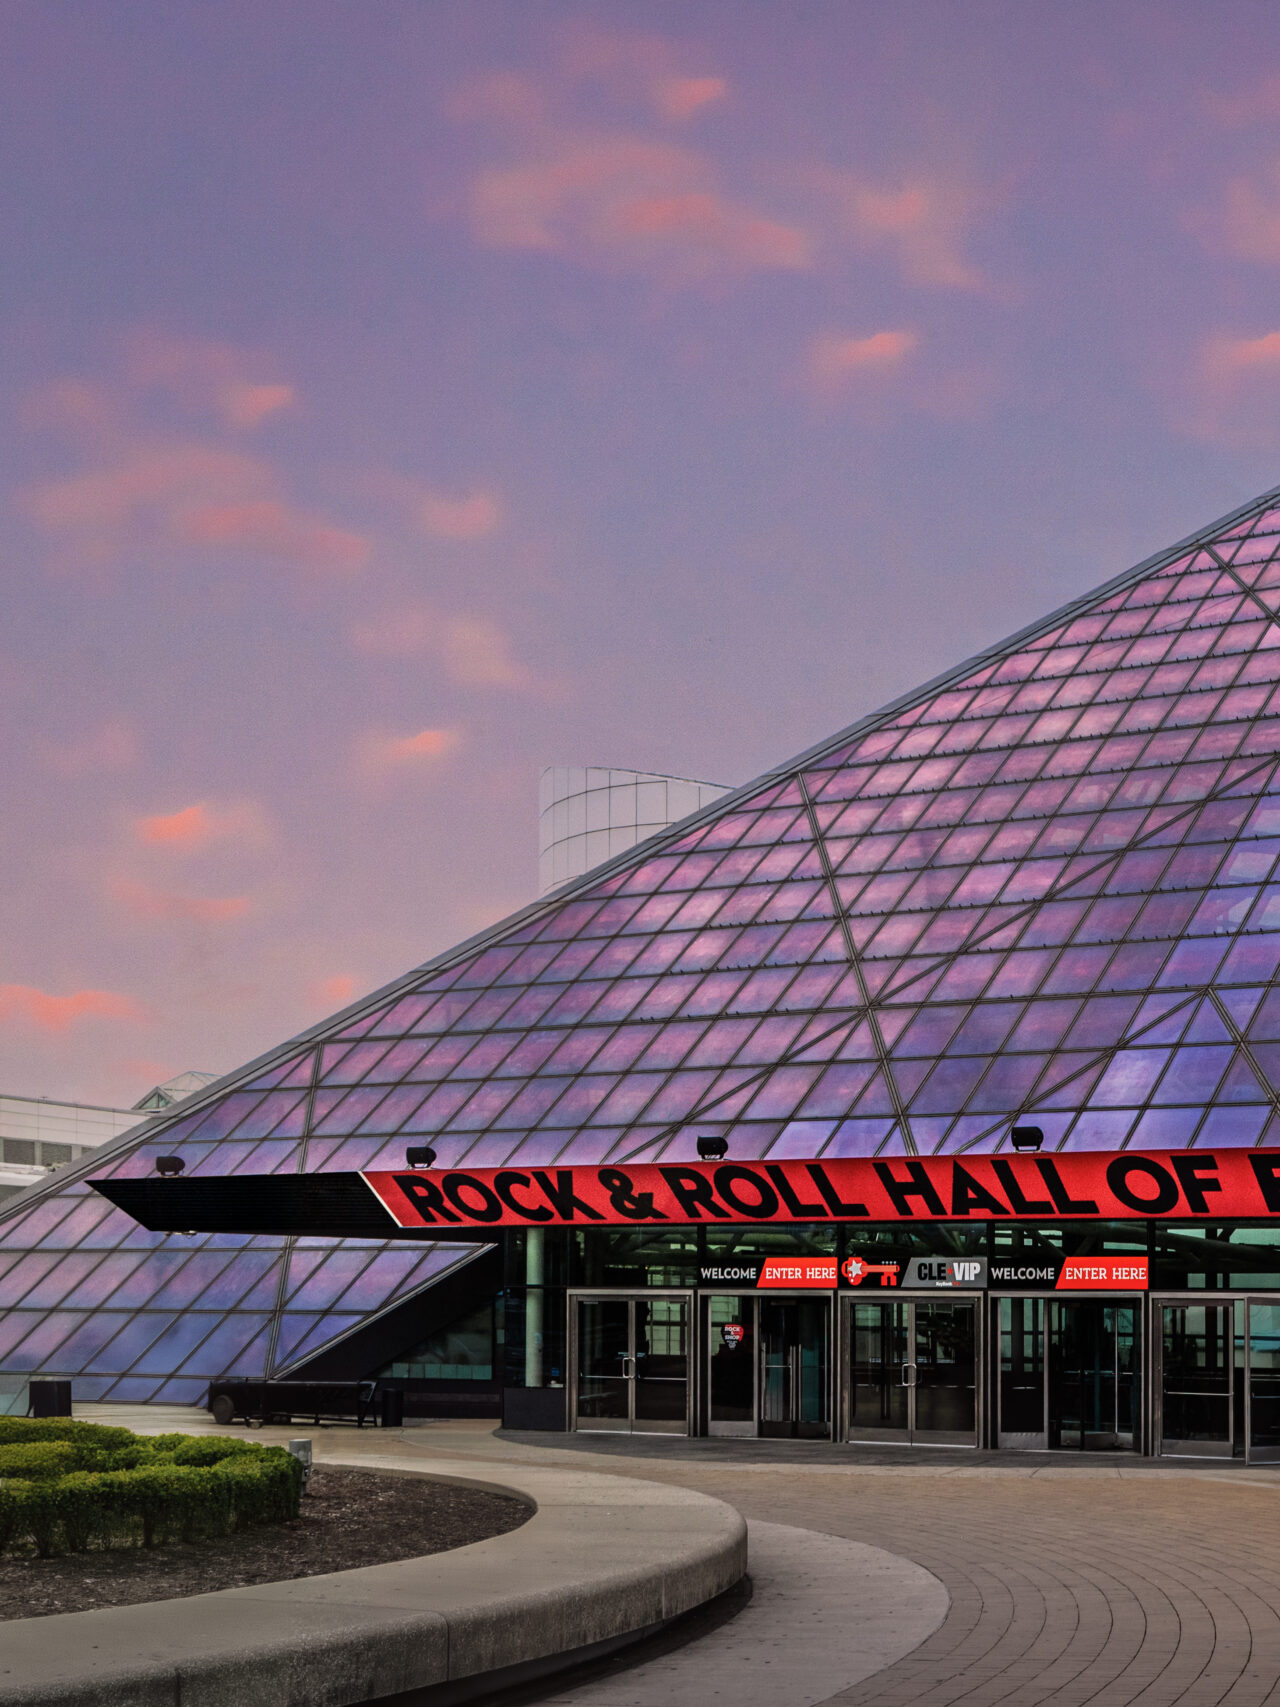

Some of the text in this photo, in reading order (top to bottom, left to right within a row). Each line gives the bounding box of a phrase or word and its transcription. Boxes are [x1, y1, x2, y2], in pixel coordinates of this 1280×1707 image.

[391, 1169, 607, 1223] ROCK
[597, 1167, 671, 1220] &
[657, 1163, 871, 1219] ROLL
[871, 1157, 1101, 1217] HALL
[1105, 1153, 1223, 1215] OF
[700, 1267, 837, 1280] WELCOME ENTER HERE
[991, 1267, 1147, 1280] WELCOME ENTER HERE
